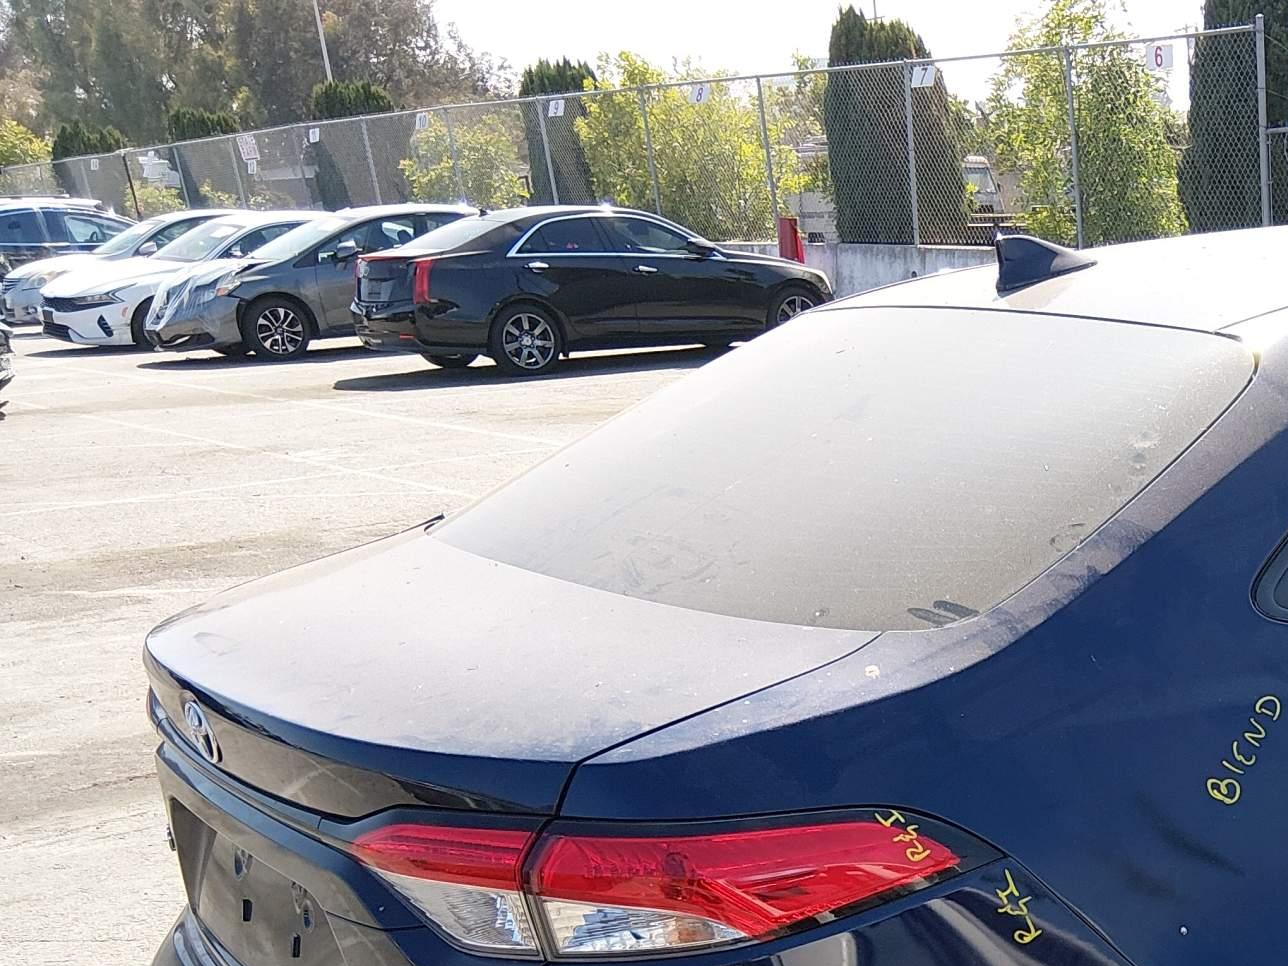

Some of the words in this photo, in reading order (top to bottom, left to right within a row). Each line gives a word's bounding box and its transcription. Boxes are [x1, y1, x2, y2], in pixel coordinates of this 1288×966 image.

[1154, 46, 1163, 68] 6
[920, 67, 928, 86] 7
[696, 87, 704, 102] 8
[553, 101, 559, 115] 9
